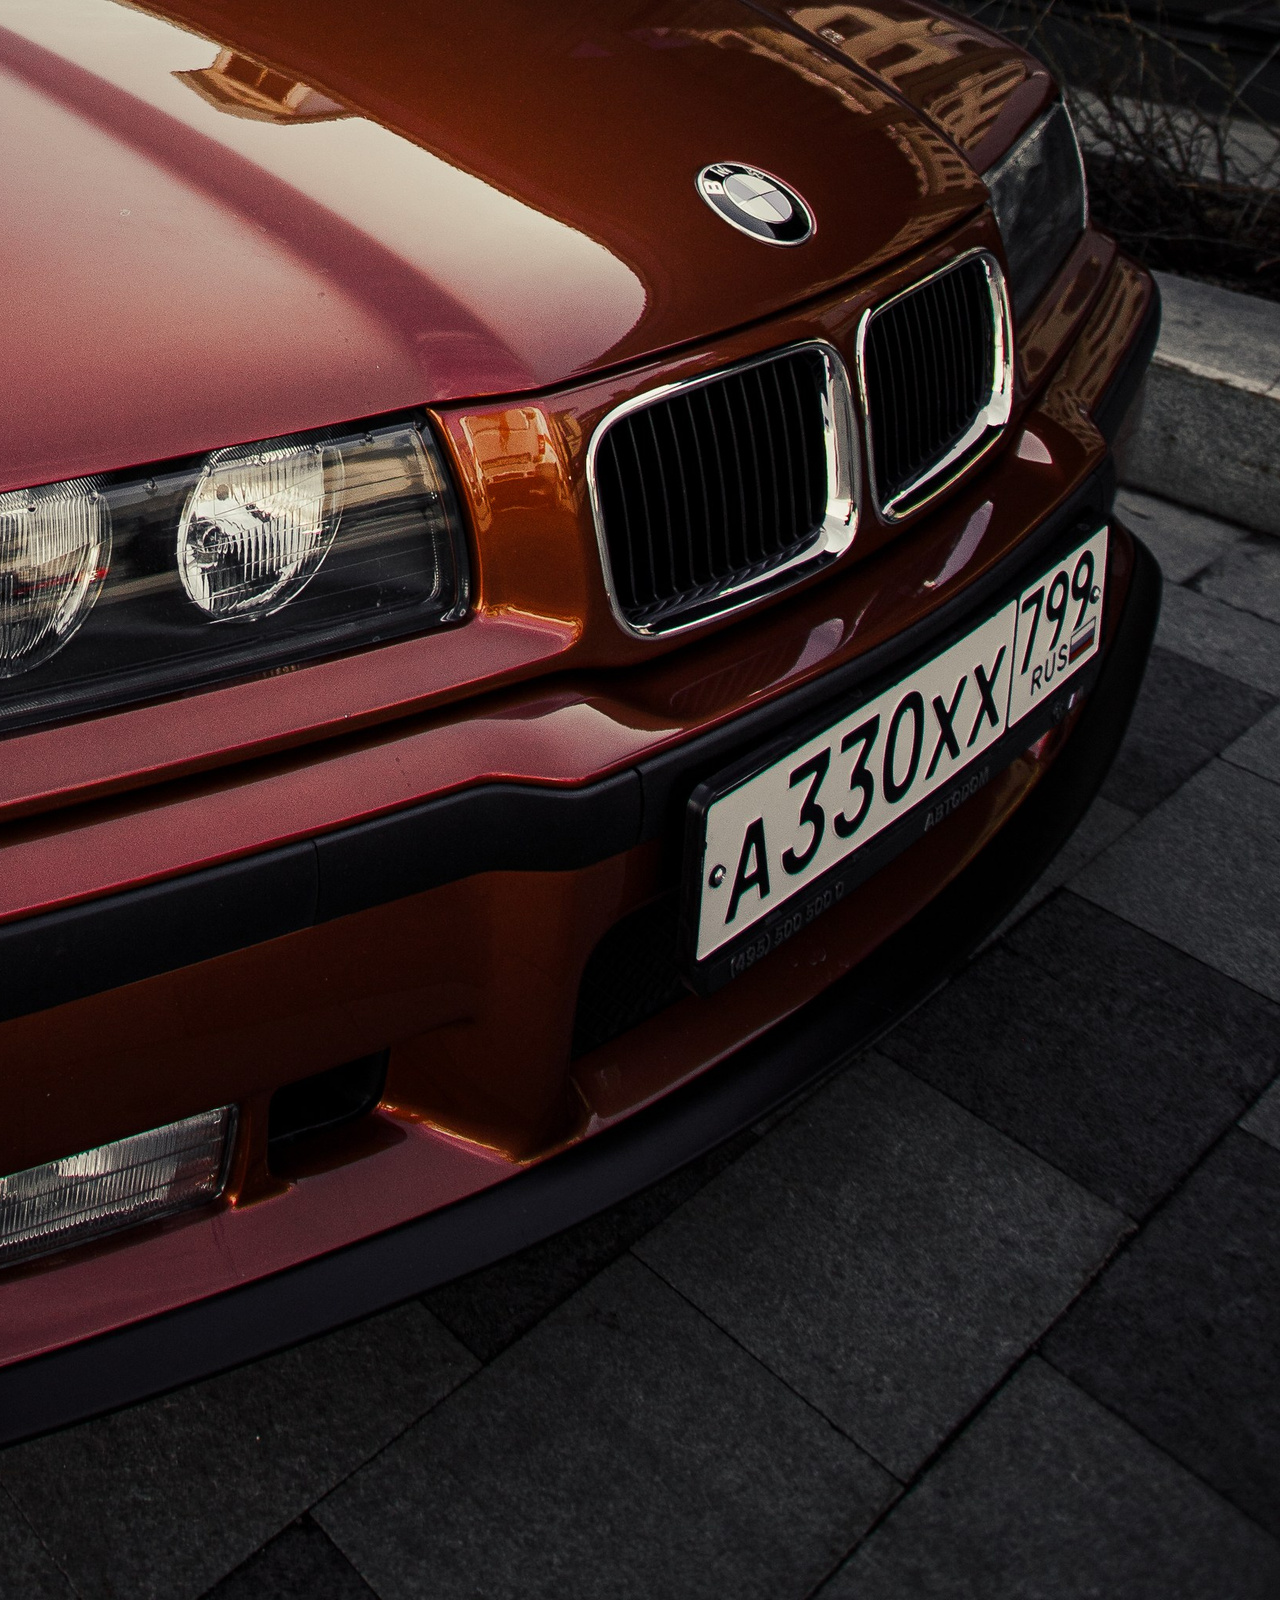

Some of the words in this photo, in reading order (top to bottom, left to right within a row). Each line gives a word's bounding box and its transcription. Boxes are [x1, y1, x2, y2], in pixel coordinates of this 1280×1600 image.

[1020, 550, 1096, 676] 799
[1030, 643, 1069, 696] RUS
[730, 932, 771, 979] (495)
[774, 911, 802, 947] 500
[806, 890, 833, 922] 500
